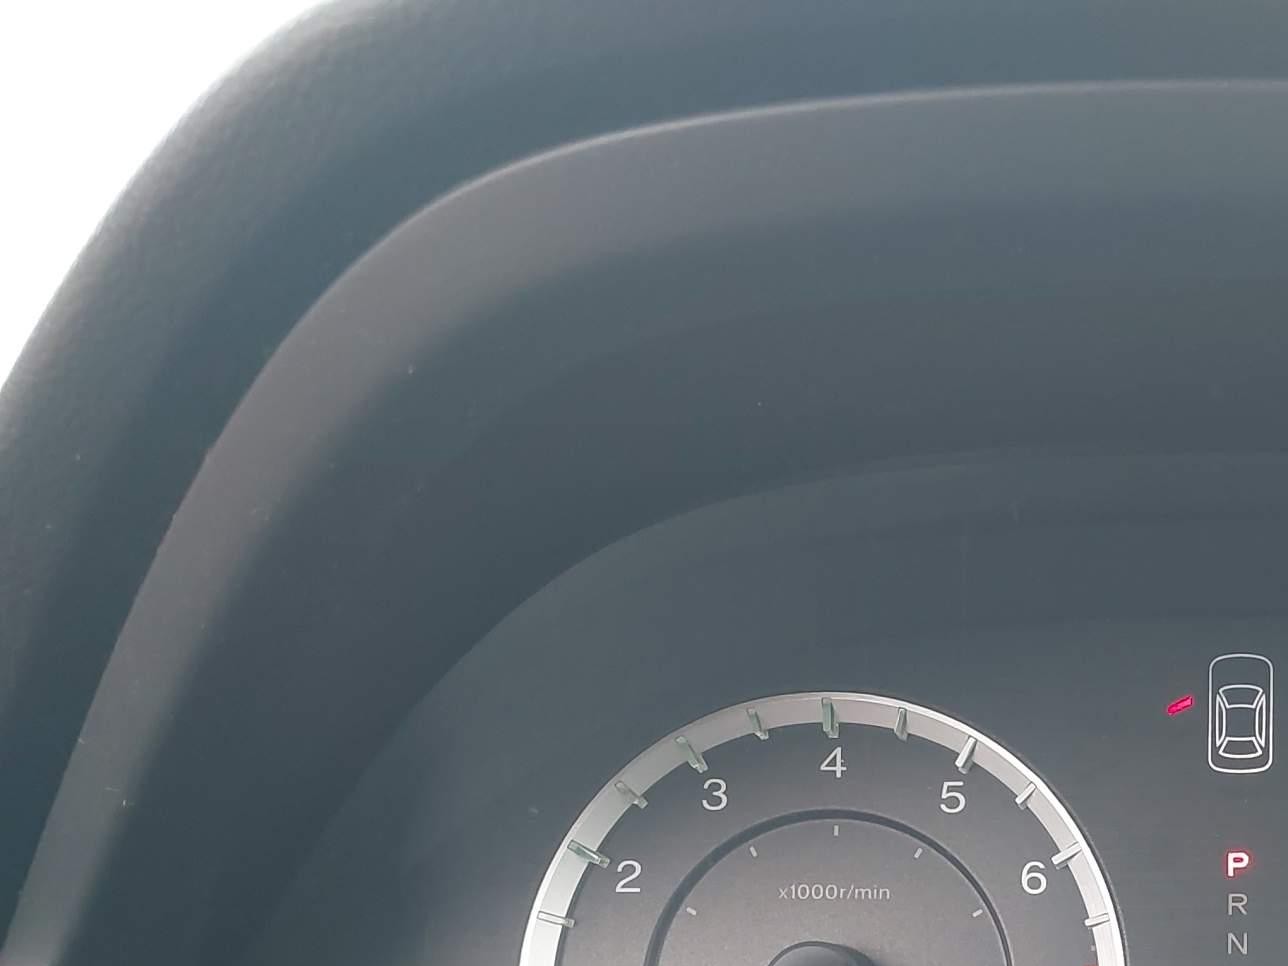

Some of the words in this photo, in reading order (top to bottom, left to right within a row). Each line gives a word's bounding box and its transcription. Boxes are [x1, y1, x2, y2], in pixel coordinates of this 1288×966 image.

[821, 747, 846, 777] 4
[703, 779, 727, 810] 3
[941, 782, 965, 813] 5
[616, 861, 641, 892] 2
[1022, 862, 1046, 894] 6
[1227, 852, 1249, 876] P
[778, 884, 890, 901] x1000r/min
[1229, 894, 1247, 915] R
[1228, 933, 1247, 954] N
